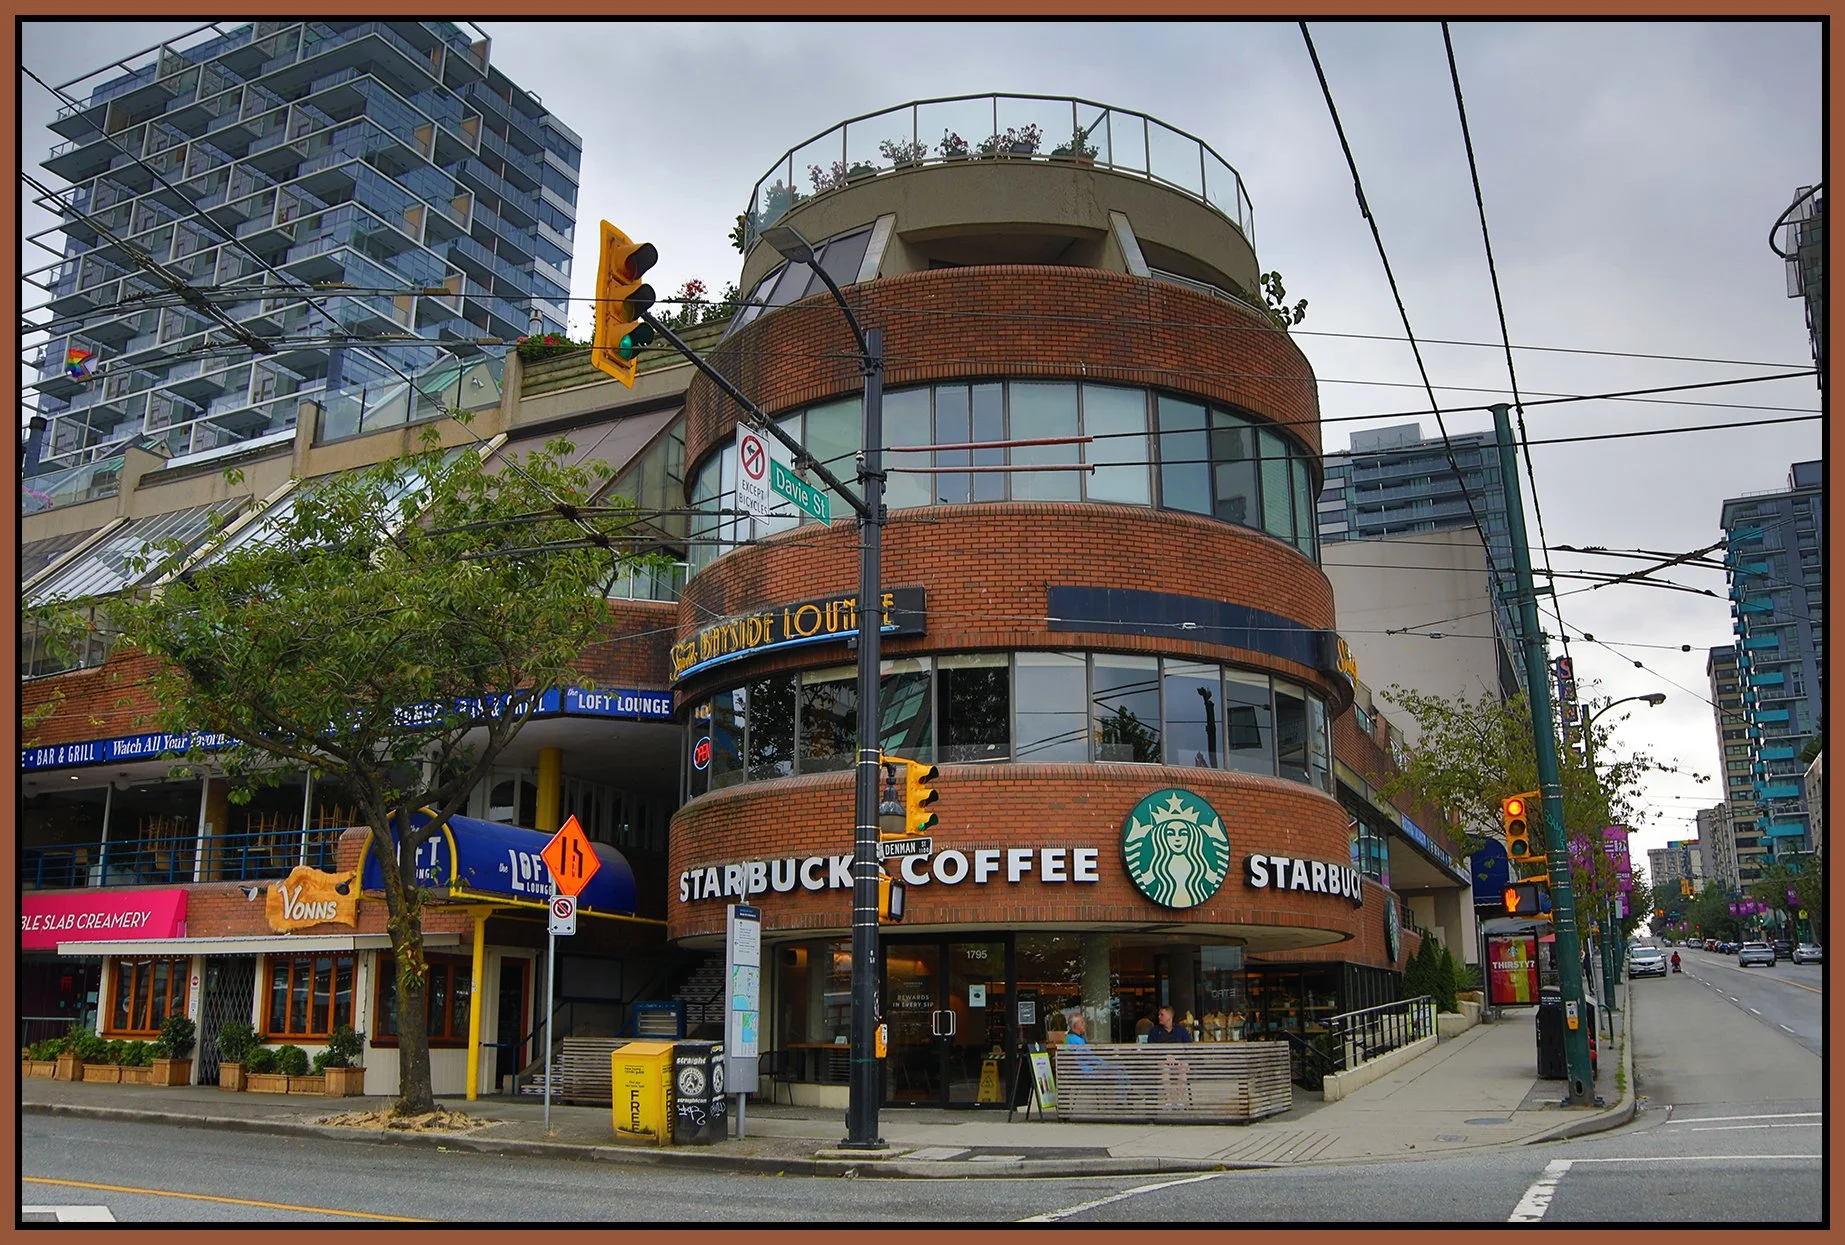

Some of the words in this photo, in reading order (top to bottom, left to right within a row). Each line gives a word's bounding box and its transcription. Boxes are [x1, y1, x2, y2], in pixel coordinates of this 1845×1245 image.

[742, 480, 764, 500] EXCEPT
[776, 466, 809, 507] Davie
[813, 493, 826, 519] St
[739, 492, 768, 515] BICYCLES
[701, 612, 775, 660] BAYSIDE
[784, 593, 894, 640] LOUNE
[567, 688, 578, 697] the
[578, 694, 612, 711] LOFT
[617, 696, 670, 714] LOUNGE
[36, 748, 55, 766] BAR
[57, 746, 65, 764] &
[67, 743, 95, 762] GRILL
[112, 738, 141, 756] Watch
[143, 735, 161, 752] All
[163, 734, 188, 750] Your
[884, 842, 916, 856] DENMAN
[499, 862, 509, 874] the
[508, 849, 553, 891] LOF
[680, 854, 887, 903] STARBUCK
[900, 847, 1100, 886] COFFEE
[42, 913, 75, 930] SLAB
[76, 911, 152, 929] CREAMERY
[966, 950, 988, 959] 1795
[1492, 960, 1536, 969] THIRSTY?
[676, 1056, 707, 1065] straight
[630, 1089, 641, 1133] FREE
